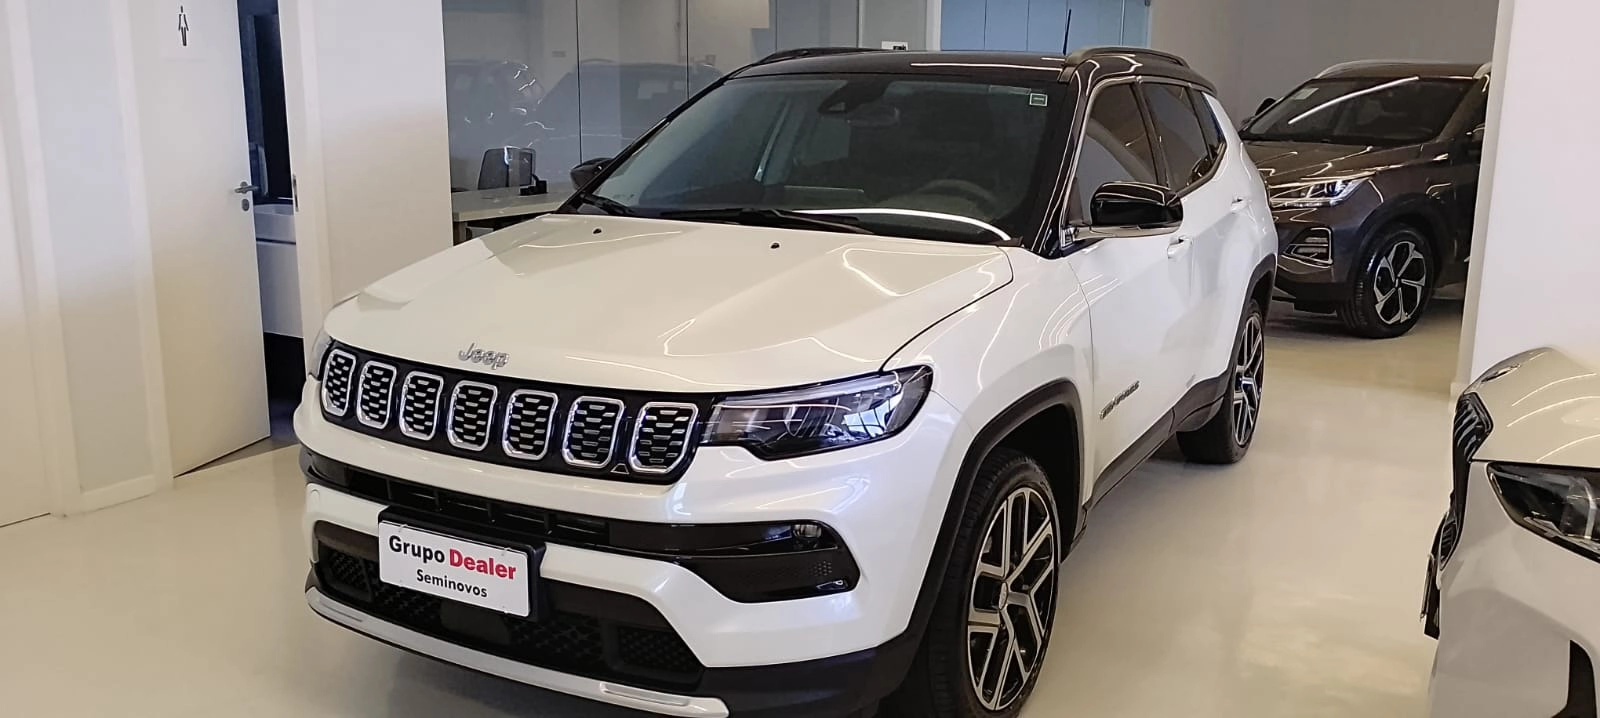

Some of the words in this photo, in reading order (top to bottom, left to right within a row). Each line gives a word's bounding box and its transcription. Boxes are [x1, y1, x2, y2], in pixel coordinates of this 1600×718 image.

[458, 342, 508, 370] Jeep
[389, 535, 445, 563] Grupo
[449, 548, 517, 580] Dealer
[416, 568, 488, 598] Seminovos
